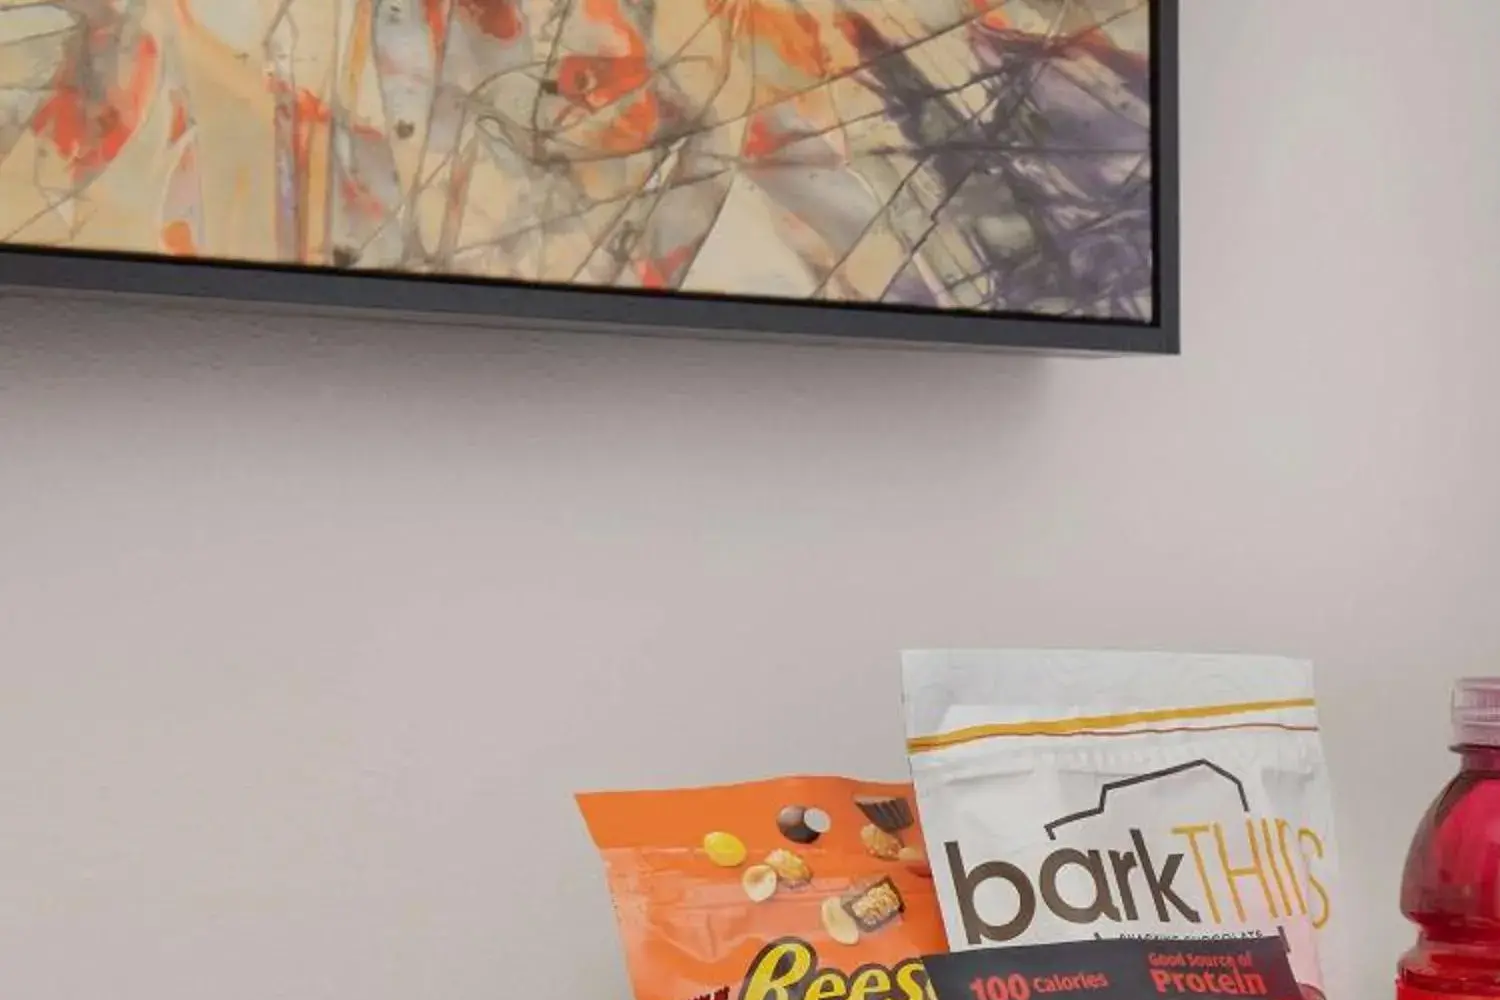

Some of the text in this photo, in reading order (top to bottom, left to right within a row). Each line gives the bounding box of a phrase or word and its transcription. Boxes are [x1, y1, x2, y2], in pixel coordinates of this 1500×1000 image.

[1148, 953, 1184, 967] Good
[1186, 952, 1237, 967] Source
[1033, 972, 1109, 993] Calories
[1150, 966, 1269, 995] Protein
